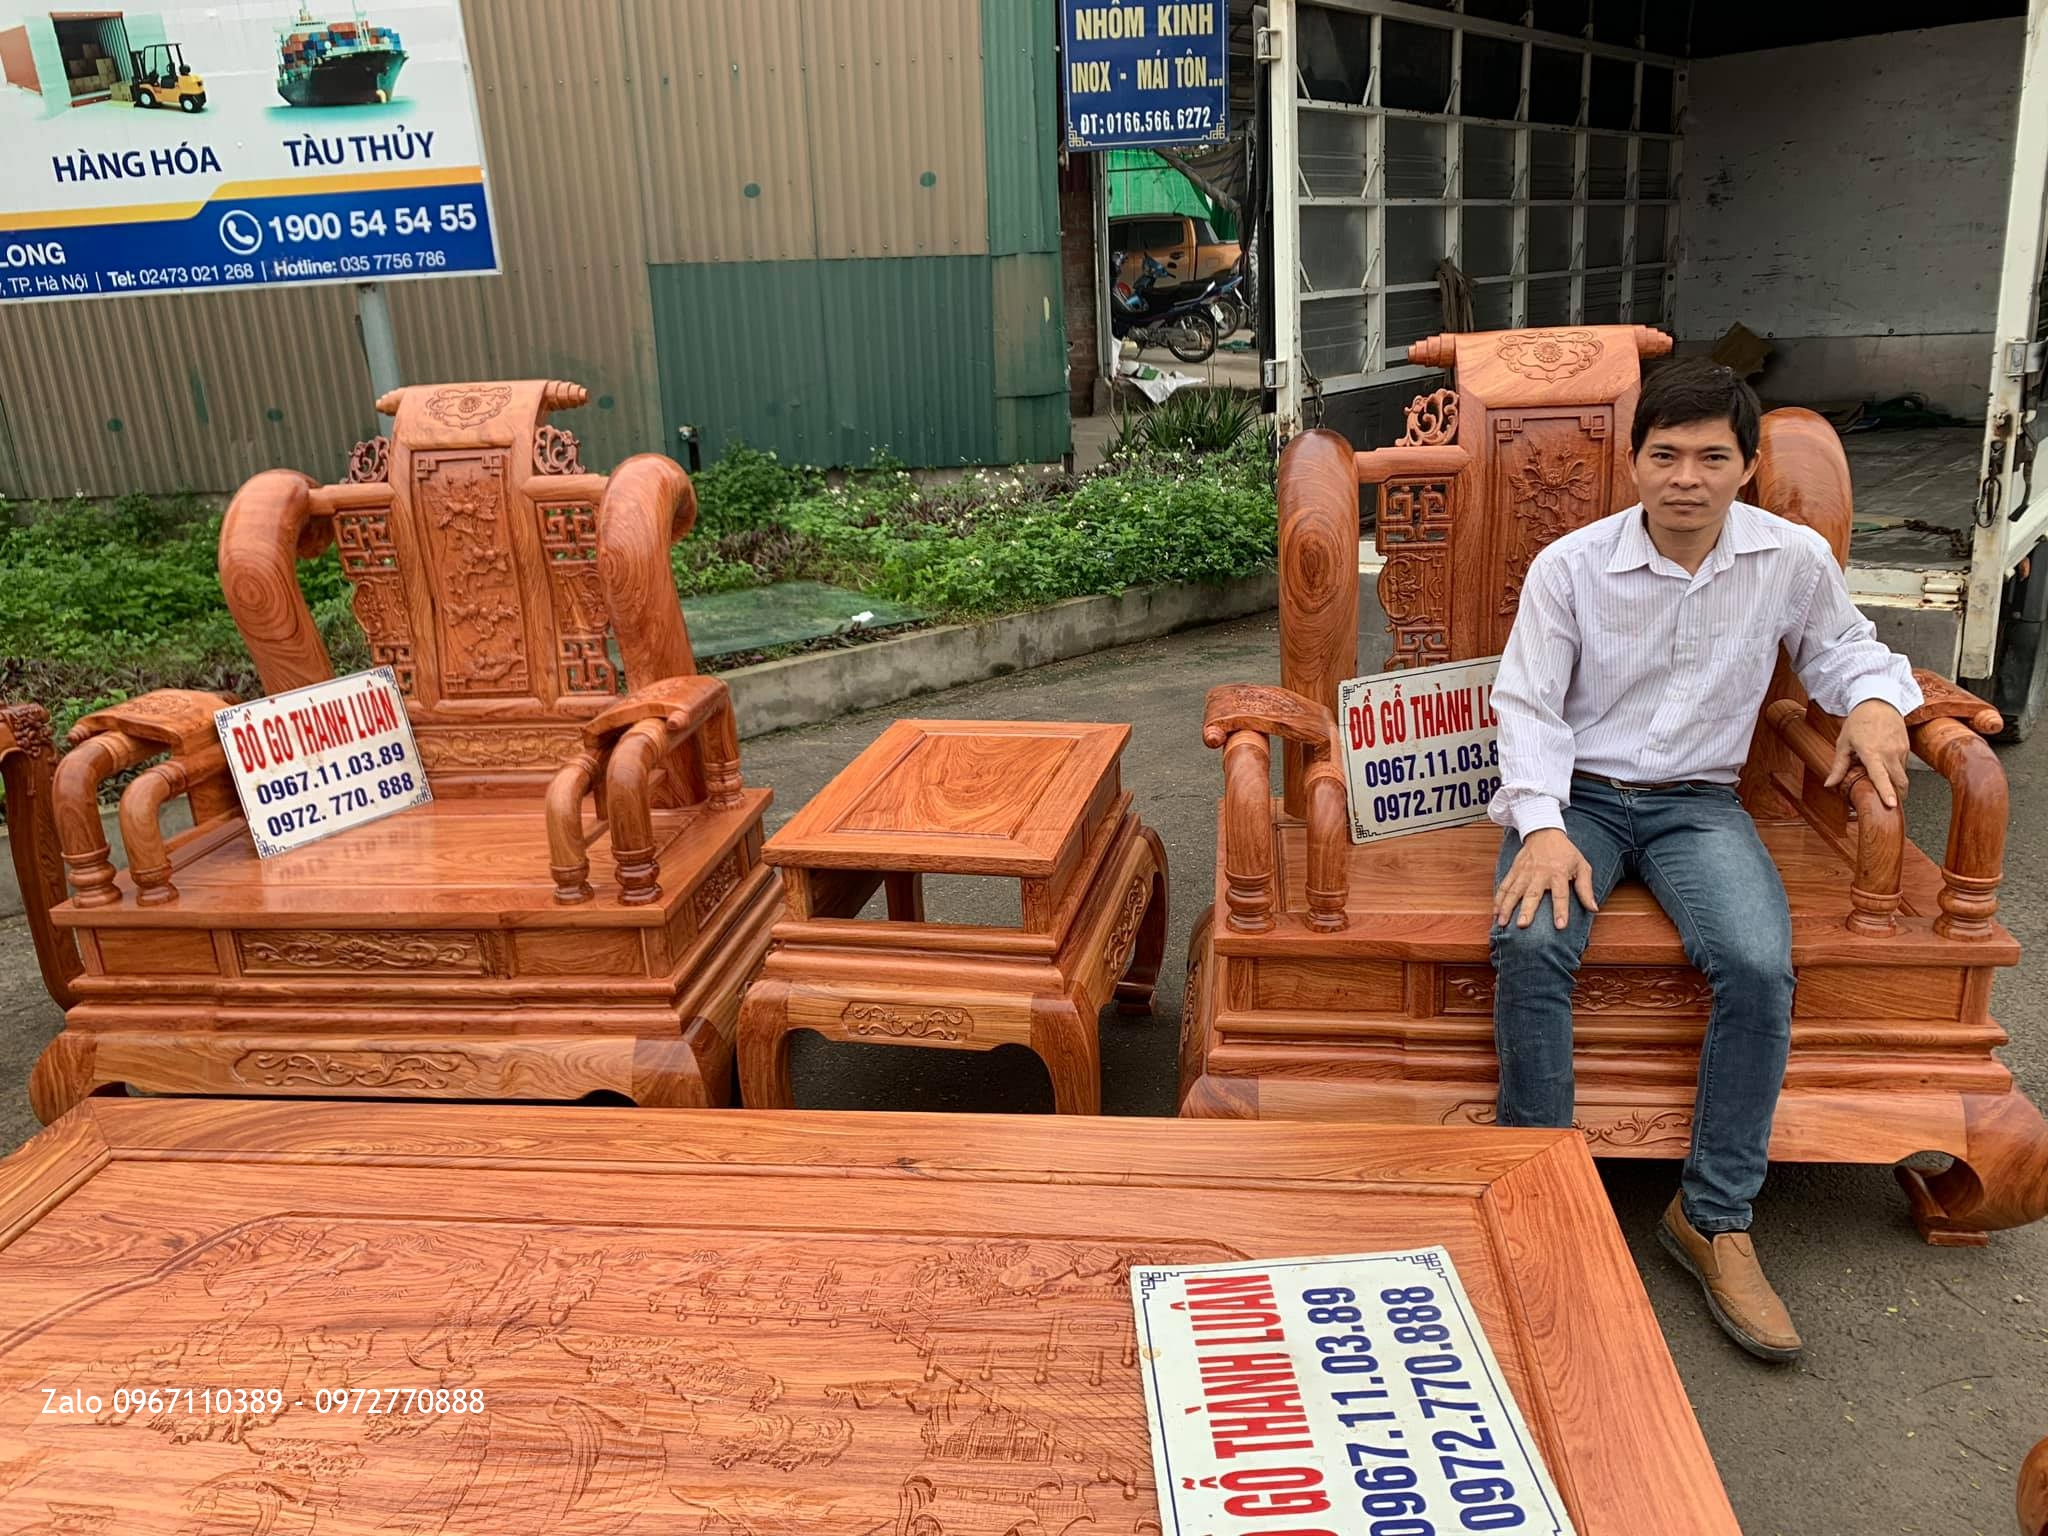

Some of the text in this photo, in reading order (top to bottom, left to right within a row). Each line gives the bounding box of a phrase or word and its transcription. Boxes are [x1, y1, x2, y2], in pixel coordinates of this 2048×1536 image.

[1075, 0, 1145, 40] NHÔM
[1071, 61, 1112, 93] INOX
[1136, 49, 1169, 90] MÁI
[52, 141, 222, 183] HÀNG HÓA
[283, 124, 434, 167] TÀU THỦY
[268, 203, 477, 244] 1900 54 54 55
[8, 277, 33, 295] TP.
[35, 275, 59, 292] Hà
[61, 273, 89, 292] Nội
[107, 270, 137, 287] Tel:
[139, 267, 188, 285] 02473
[191, 265, 219, 281] 021
[224, 263, 254, 280] 268
[273, 258, 338, 277] Hotline:
[340, 256, 370, 272] 035
[373, 253, 413, 270] 7756
[416, 250, 446, 267] 786
[231, 708, 266, 774] ĐỒ
[288, 697, 354, 757] THÀNH
[348, 680, 399, 739] LUÂN
[1349, 688, 1377, 751] ĐỒ
[1380, 683, 1406, 746] GỖ
[1410, 682, 1473, 740] THÀNH
[256, 741, 406, 805] 0967.11.03.89
[1365, 739, 1499, 788] 0967.11.03.8
[1373, 776, 1501, 823] 0972.770.88
[1169, 1274, 1286, 1346] LUÂN
[1184, 1352, 1315, 1459] THÀNH
[1380, 1286, 1526, 1531] 0972.770.888
[1181, 1466, 1332, 1517] GỖ
